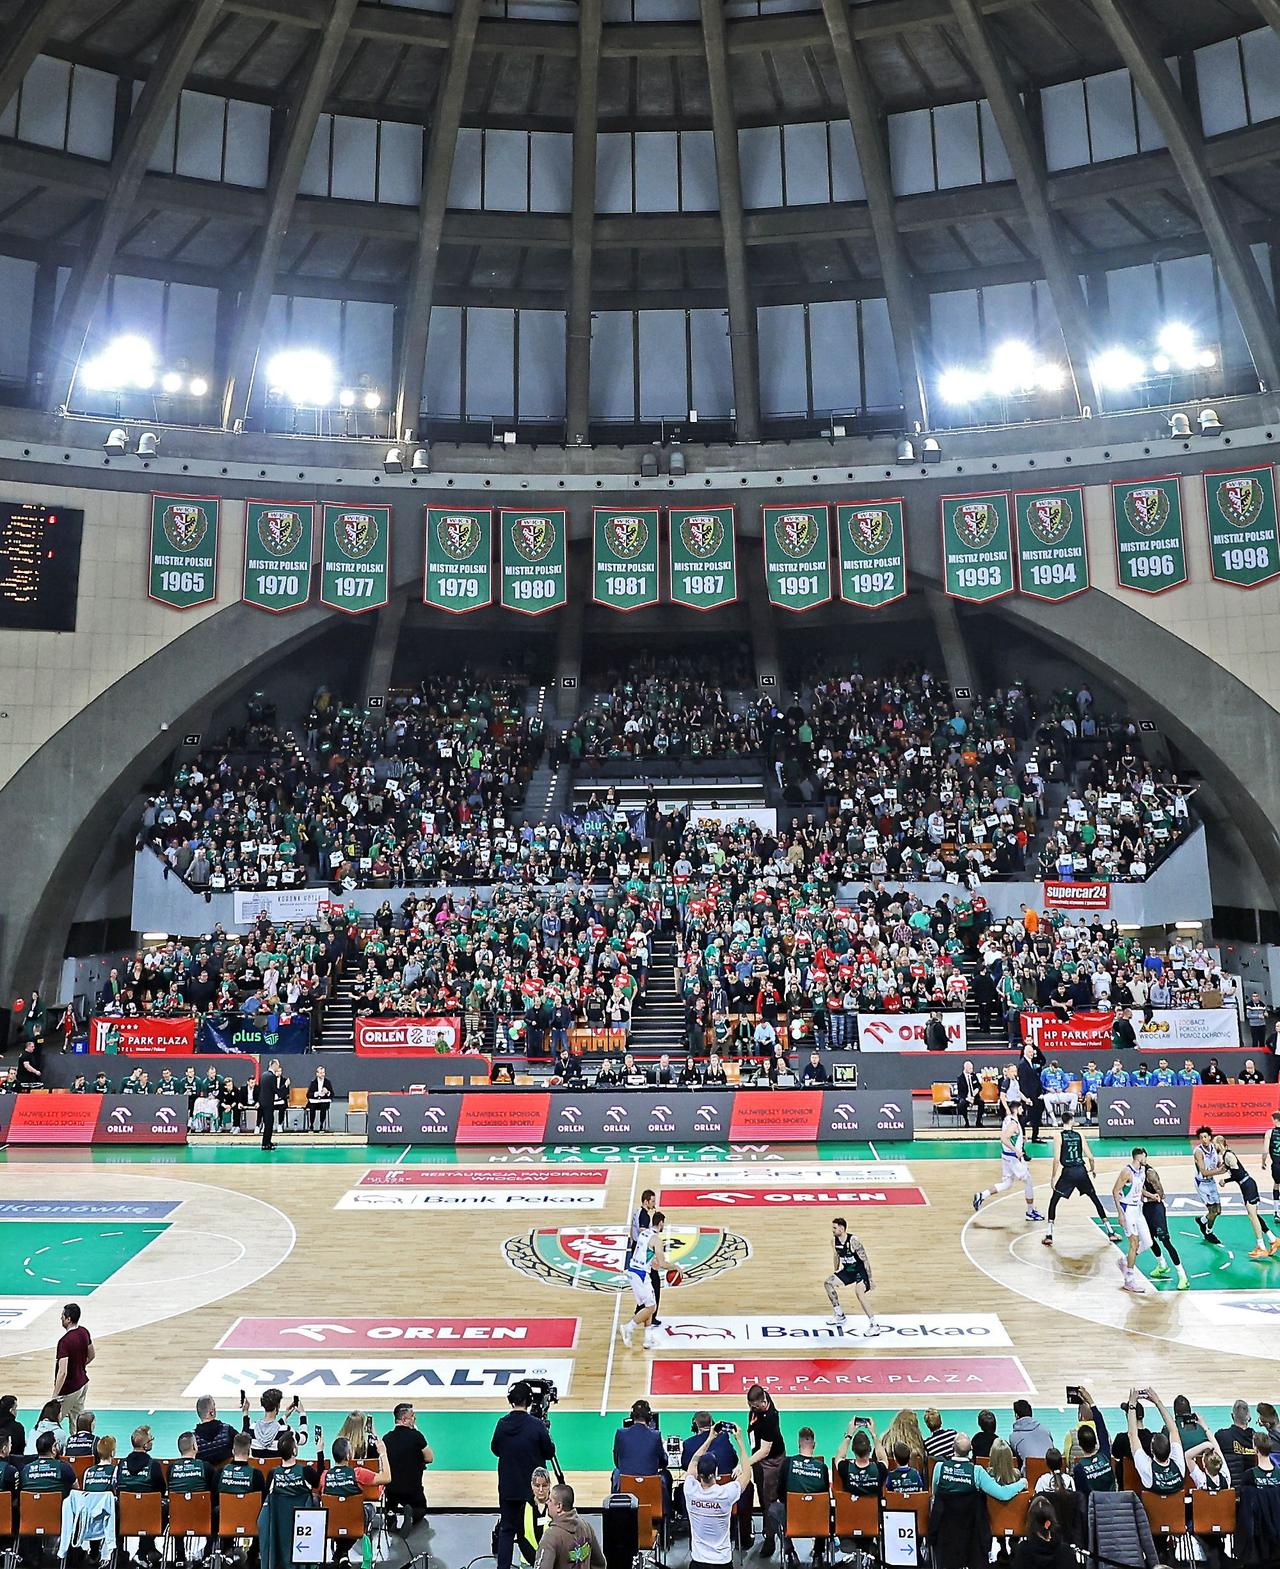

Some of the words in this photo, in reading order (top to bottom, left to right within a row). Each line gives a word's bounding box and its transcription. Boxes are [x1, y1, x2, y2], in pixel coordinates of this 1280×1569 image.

[1213, 533, 1244, 545] MISTRZ
[1245, 530, 1274, 542] POLSKI
[1120, 542, 1150, 552] MISTRZ
[1151, 538, 1179, 550] POLSKI
[948, 553, 978, 564] MISTRZ
[979, 551, 1007, 562] POLSKI
[1022, 550, 1053, 561] MISTRZ
[1054, 547, 1082, 559] POLSKI
[1222, 546, 1269, 570] 1998
[154, 555, 184, 566] MISTRZ
[184, 557, 212, 568] POLSKI
[248, 559, 278, 570] MISTRZ
[279, 561, 307, 571] POLSKI
[326, 561, 355, 572] MISTRZ
[356, 563, 384, 573] POLSKI
[598, 562, 627, 572] MISTRZ
[628, 562, 654, 572] POLSKI
[674, 562, 704, 571] MISTRZ
[704, 560, 731, 570] POLSKI
[769, 562, 798, 572] MISTRZ
[799, 561, 826, 572] POLSKI
[844, 559, 873, 570] MISTRZ
[874, 556, 900, 568] POLSKI
[1128, 554, 1174, 578] 1996
[430, 564, 459, 574] MISTRZ
[460, 564, 487, 574] POLSKI
[505, 565, 534, 576] MISTRZ
[535, 564, 562, 574] POLSKI
[1030, 563, 1077, 585] 1994
[160, 571, 205, 593] 1965
[956, 566, 1002, 587] 1993
[257, 575, 298, 595] 1970
[335, 577, 374, 597] 1977
[438, 578, 479, 598] 1979
[606, 577, 647, 595] 1981
[682, 575, 725, 594] 1987
[778, 576, 818, 595] 1991
[851, 572, 895, 594] 1992
[512, 579, 556, 599] 1980
[563, 678, 576, 687] C1
[762, 676, 775, 685] C1
[957, 688, 970, 697] C1
[369, 698, 383, 706] C1
[1141, 722, 1156, 731] C1
[185, 736, 199, 744] C1
[1047, 886, 1107, 898] supercar24
[233, 1030, 261, 1044] plus
[365, 1032, 404, 1042] ORLEN
[898, 1023, 961, 1041] ORN
[1044, 1031, 1058, 1040] HP
[1062, 1031, 1088, 1040] PARK
[128, 1036, 154, 1045] PARK
[158, 1036, 188, 1045] PLAZA
[831, 1122, 858, 1130] ORLEN
[1107, 1118, 1134, 1126] ORLEN
[1153, 1117, 1180, 1125] ORLEN
[107, 1125, 134, 1133] ORLEN
[151, 1125, 178, 1133] ORLEN
[376, 1125, 403, 1133] ORLEN
[421, 1125, 448, 1133] ORLEN
[557, 1124, 585, 1132] ORLEN
[603, 1124, 630, 1132] ORLEN
[648, 1124, 675, 1132] ORLEN
[694, 1124, 721, 1132] ORLEN
[604, 1154, 784, 1162] STULECIA
[424, 1195, 494, 1204] Bank
[506, 1195, 595, 1204] Pekao
[763, 1193, 886, 1201] ORLEN
[367, 1327, 528, 1339] ORLEN
[762, 1325, 857, 1338] Bank
[868, 1324, 991, 1337] Pekao
[256, 1368, 526, 1385] BAZALT
[742, 1376, 780, 1384] HP
[795, 1375, 873, 1383] PARK
[888, 1374, 983, 1383] PLAZA
[691, 1500, 721, 1510] POLSKA
[296, 1526, 312, 1537] B2
[898, 1528, 914, 1539] D2
